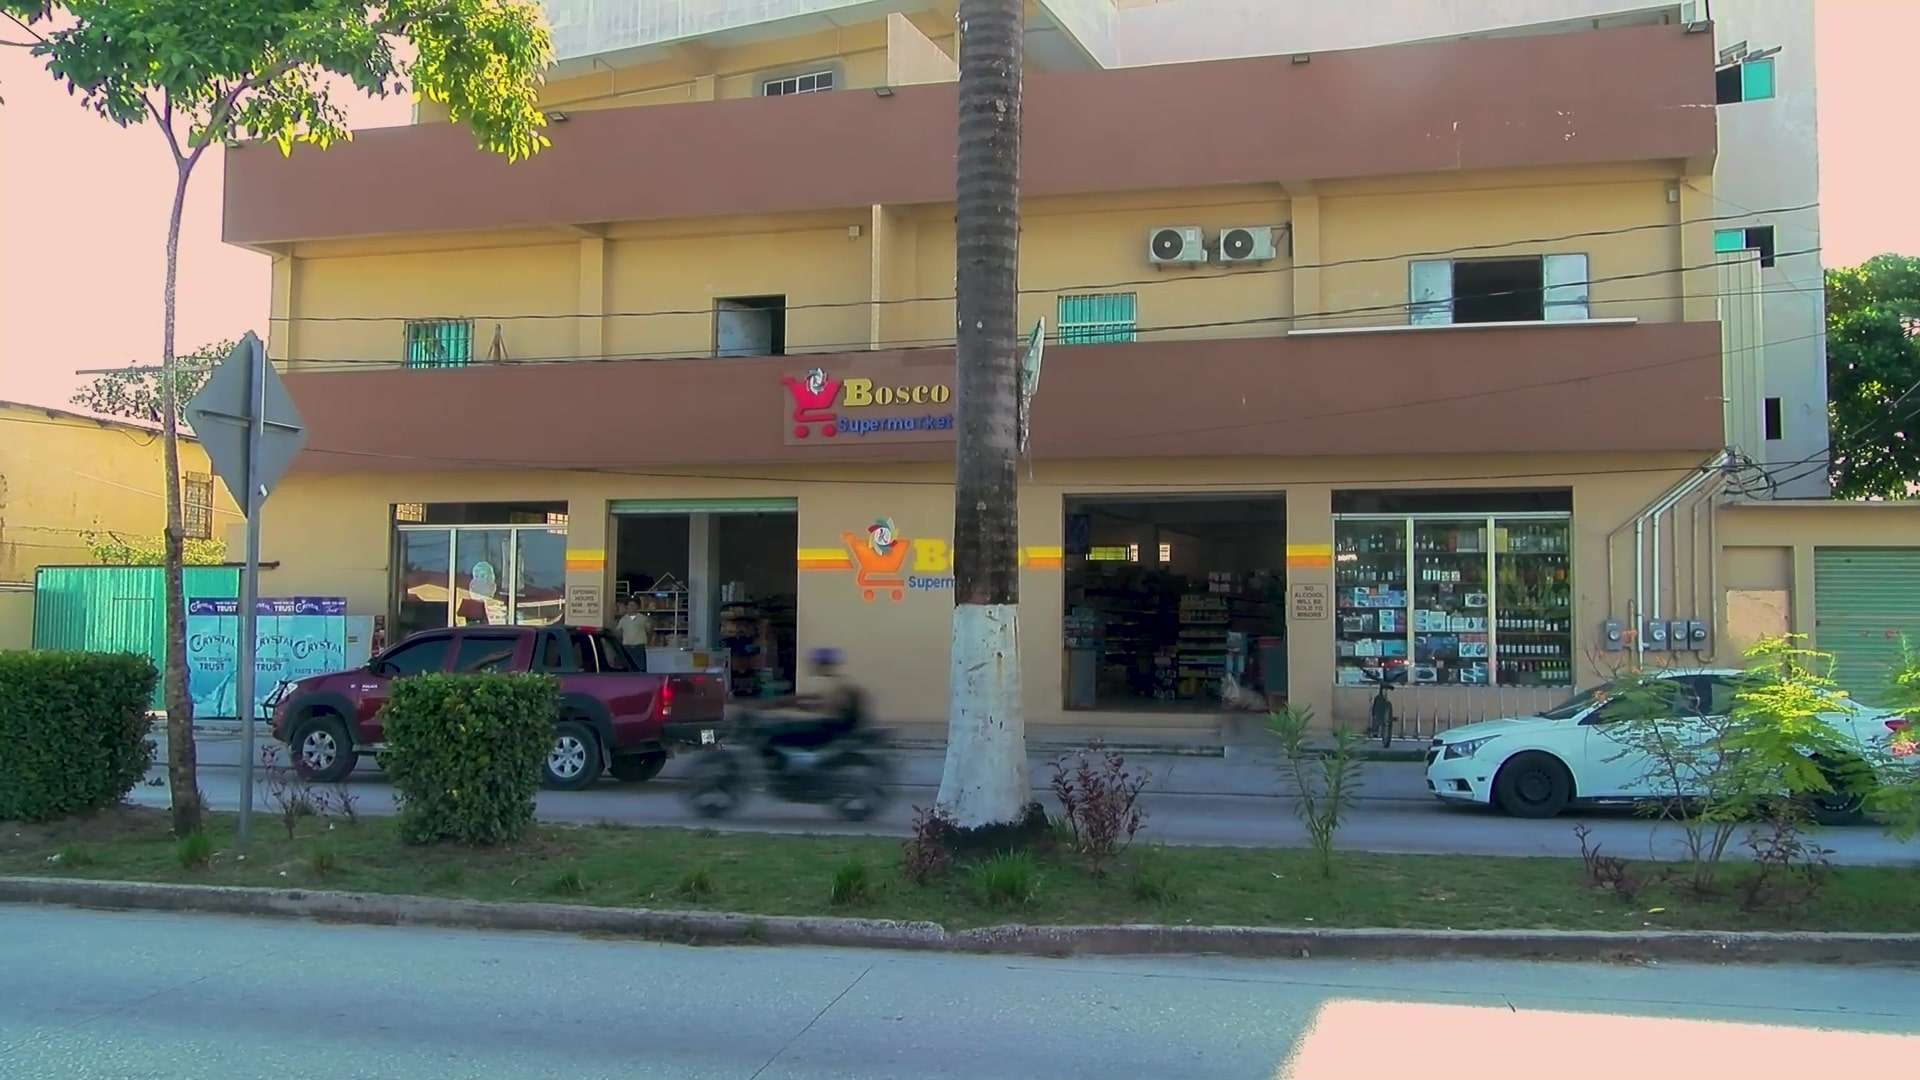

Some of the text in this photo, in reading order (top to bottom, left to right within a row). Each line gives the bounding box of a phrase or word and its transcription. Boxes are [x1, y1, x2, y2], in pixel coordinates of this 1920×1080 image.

[843, 378, 950, 406] Bosco
[838, 413, 954, 436] Supermarket
[908, 575, 955, 591] Superm
[256, 634, 293, 652] RYSTAL
[293, 639, 343, 660] CRYSTAL
[199, 662, 225, 671] TRUST
[256, 663, 283, 672] TRUST
